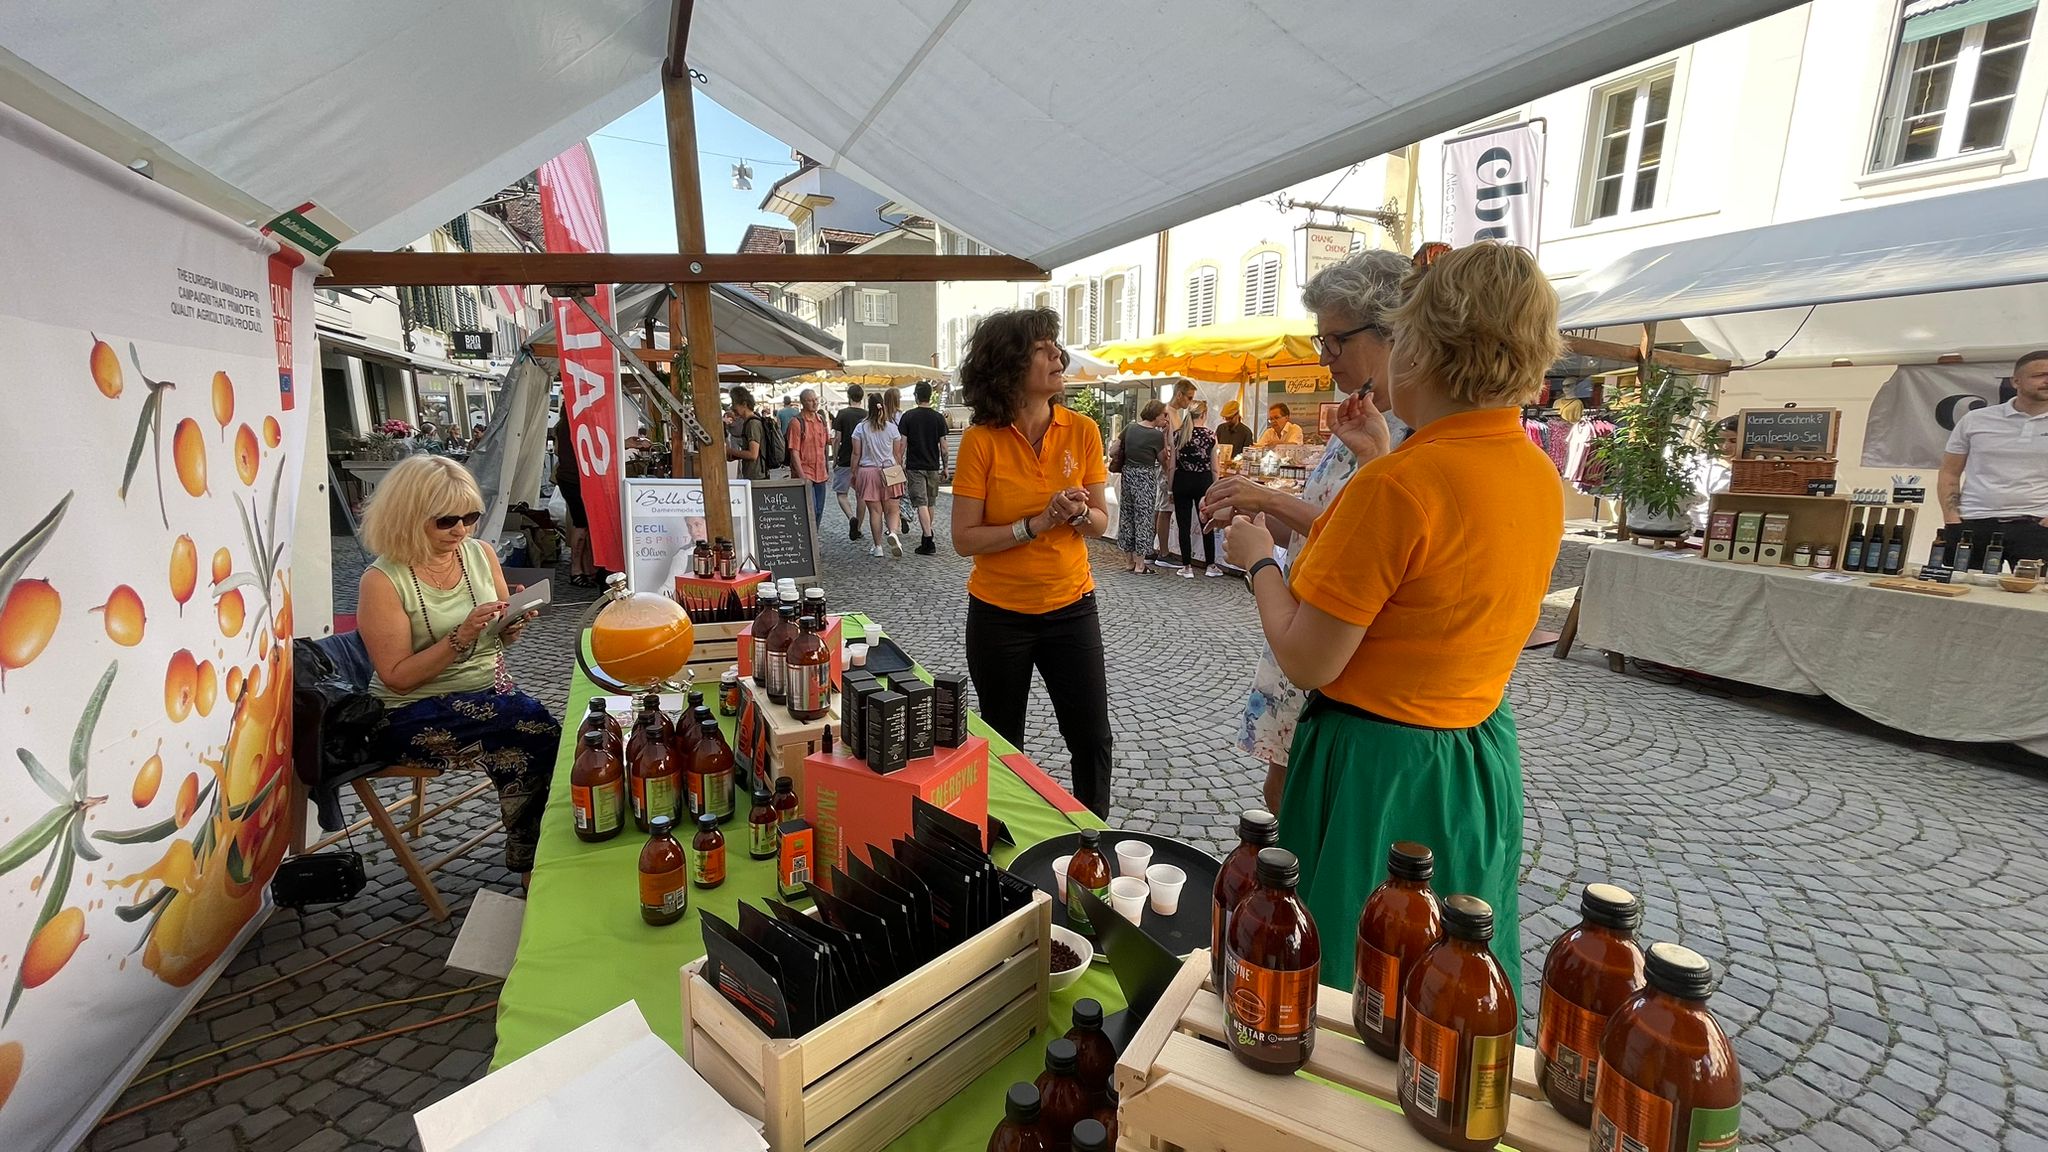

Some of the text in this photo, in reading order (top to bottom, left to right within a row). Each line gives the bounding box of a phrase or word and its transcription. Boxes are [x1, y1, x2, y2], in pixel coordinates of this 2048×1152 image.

[1475, 146, 1529, 241] cb
[1311, 234, 1334, 244] CHANG
[1325, 244, 1347, 253] CHENG
[1747, 413, 1824, 425] Kleines Geschenk?
[635, 488, 687, 507] Bella
[634, 524, 668, 534] CECIL
[635, 535, 689, 545] ESPRIT
[930, 763, 980, 808] ENERGYNE
[1233, 1018, 1265, 1041] NEKTAR
